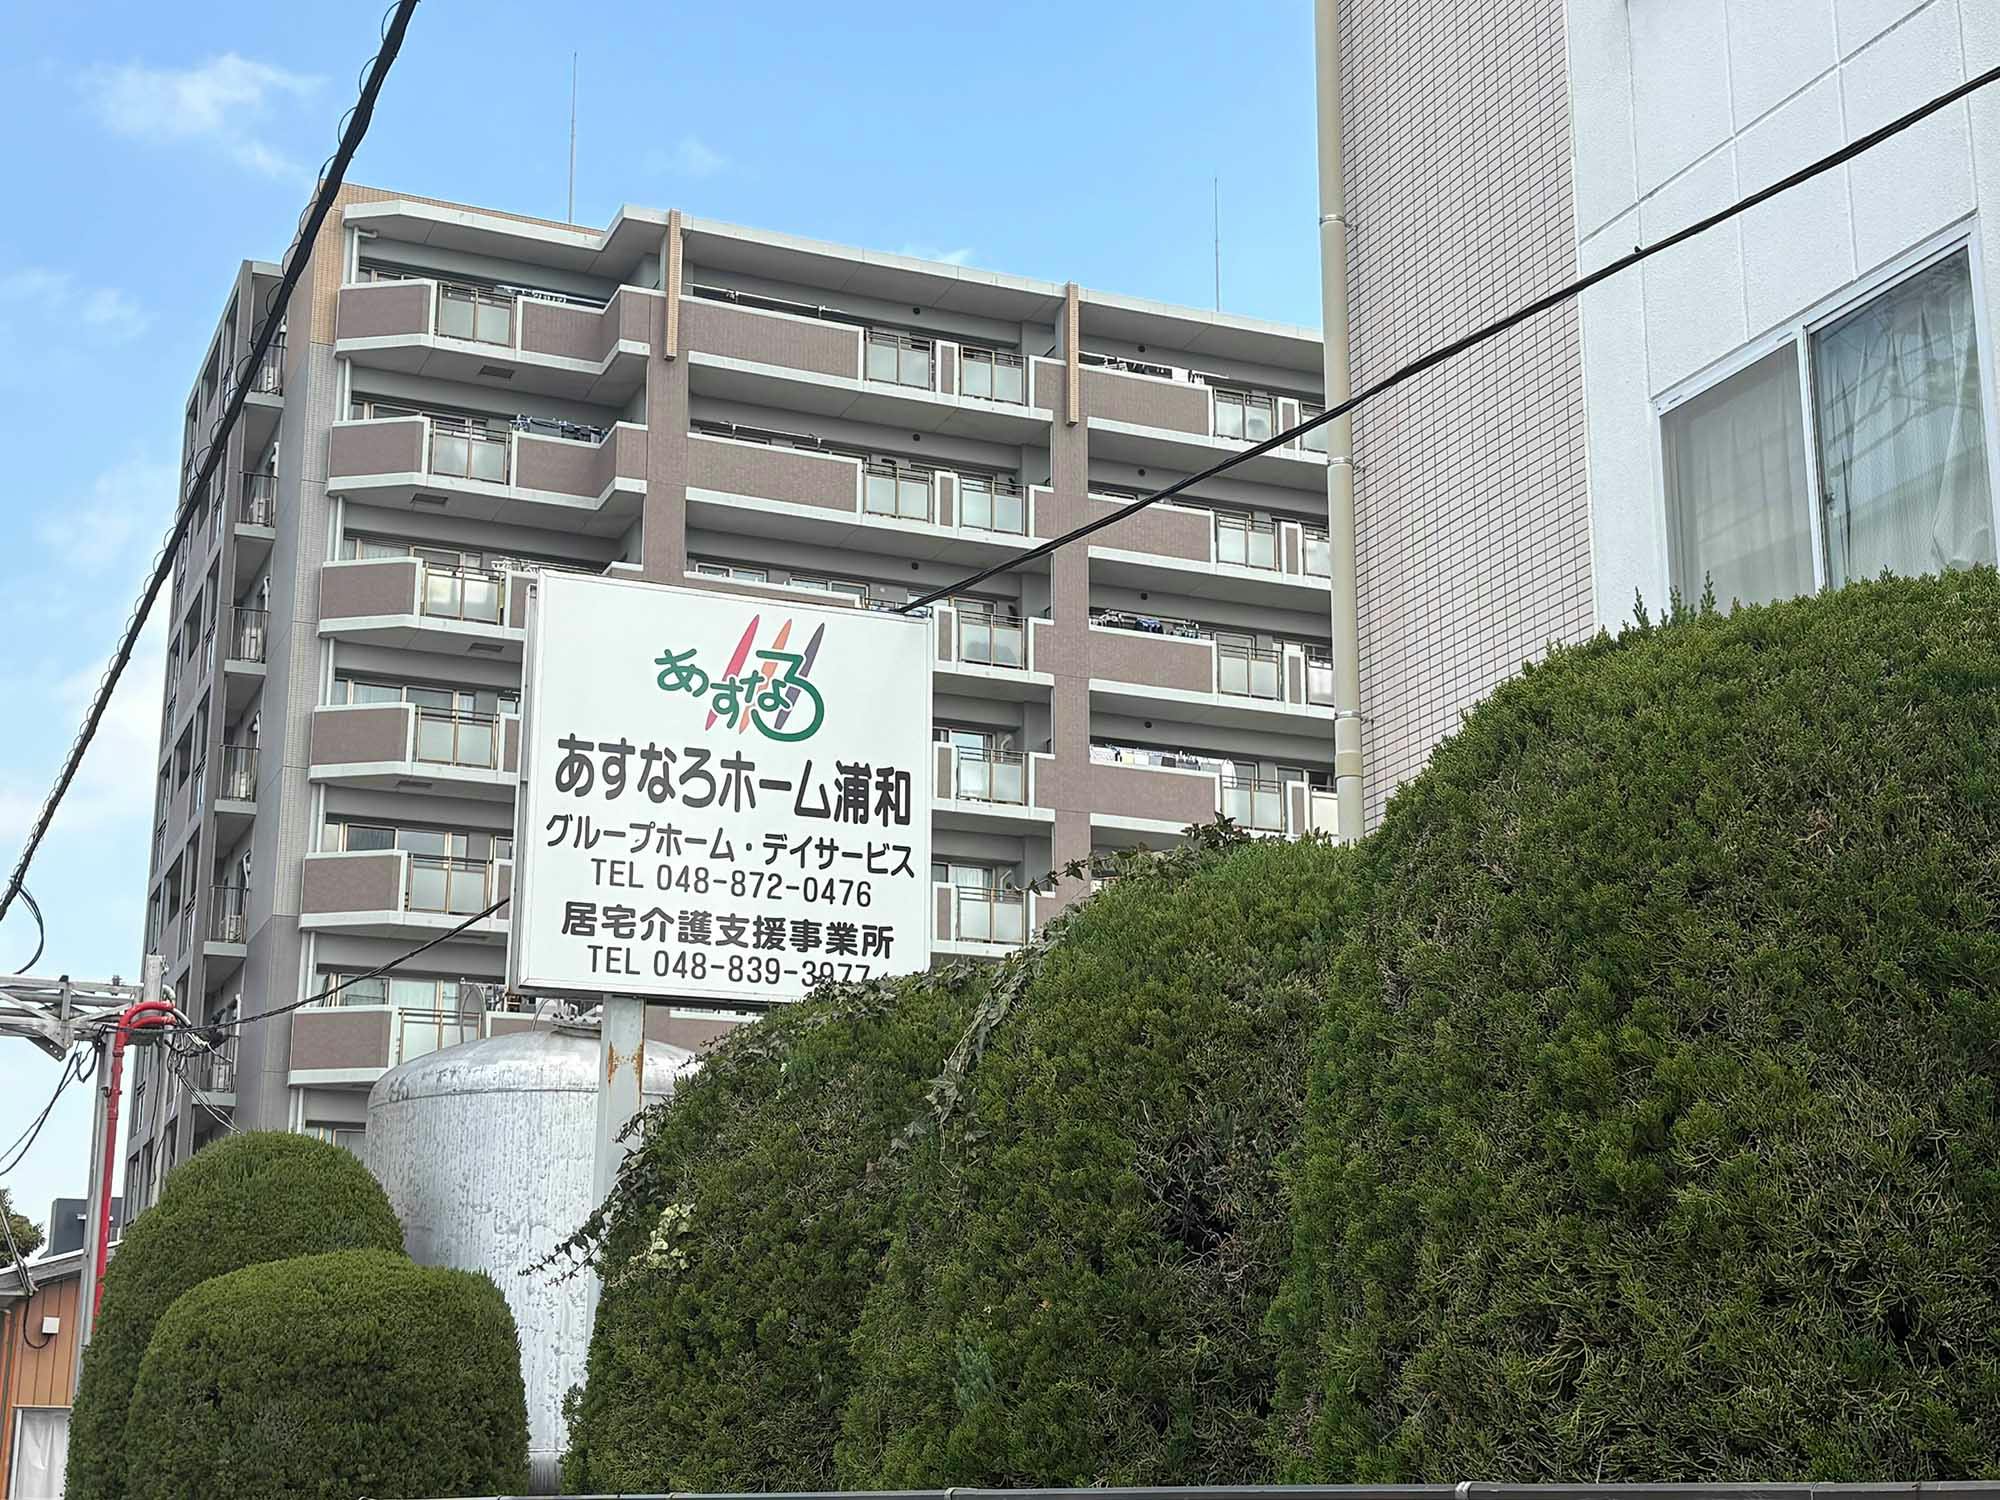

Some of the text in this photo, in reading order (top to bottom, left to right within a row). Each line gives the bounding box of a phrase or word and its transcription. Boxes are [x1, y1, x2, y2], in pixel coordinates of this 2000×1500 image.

[654, 648, 825, 742] あすなろ
[555, 733, 911, 827] あすなろホーム浦和
[591, 858, 871, 907] TEL 048-872-0476
[561, 901, 895, 959] 居宅介護支援事業所
[588, 945, 641, 975] TEL
